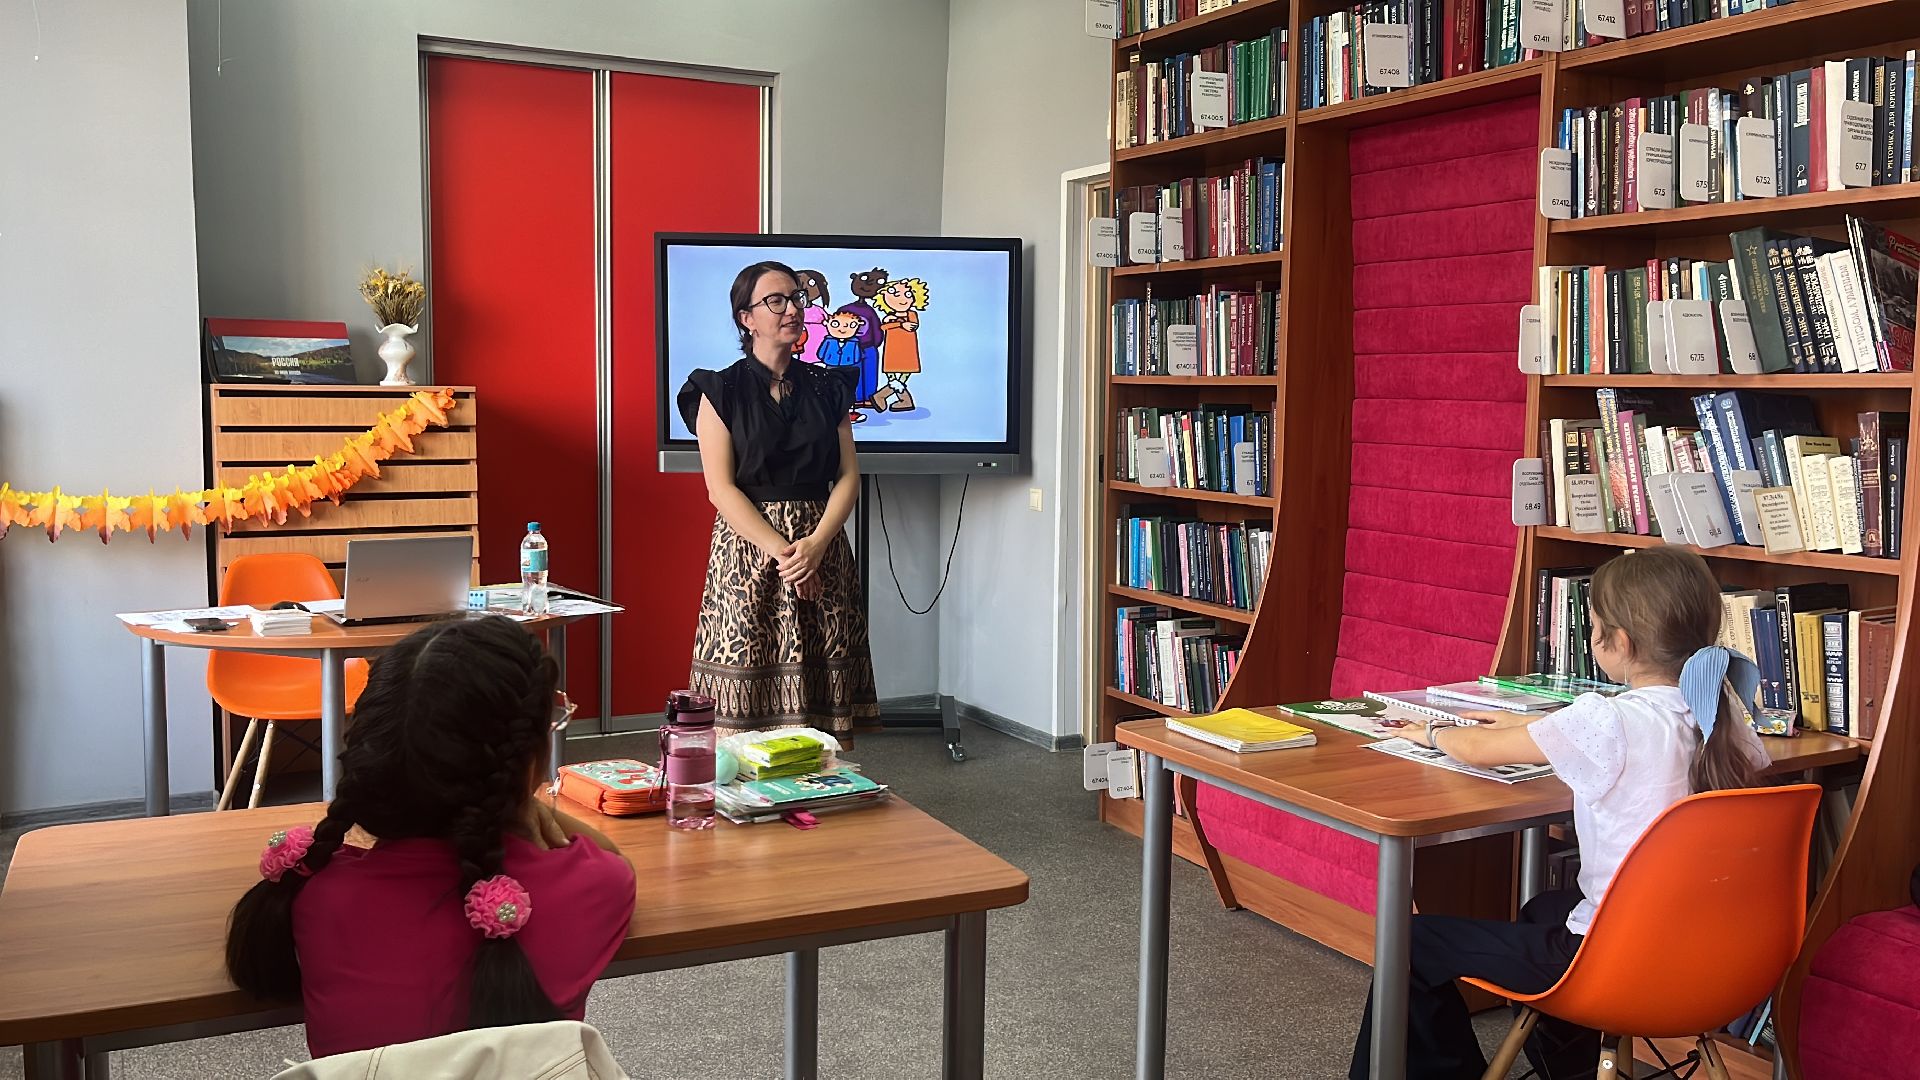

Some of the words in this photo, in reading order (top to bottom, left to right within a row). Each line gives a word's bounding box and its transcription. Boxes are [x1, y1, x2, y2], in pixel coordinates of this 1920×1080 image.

[1597, 14, 1616, 24] 67.412
[1533, 34, 1551, 43] 67.411
[1379, 68, 1400, 76] 67.408
[1889, 70, 1897, 109] ЮРИСТОВ
[1888, 110, 1896, 127] ДЛЯ
[1887, 129, 1895, 170] РИТОРИКА
[1855, 162, 1868, 171] 67.7
[1755, 175, 1771, 185] 67.52
[1653, 187, 1667, 197] 67.5
[1774, 271, 1790, 315] ДЕЛЬБРЮК
[1787, 271, 1804, 315] ДЕЛЬБРЮК
[1810, 270, 1826, 315] ДЕЛЬБРЮК
[1784, 316, 1796, 338] ГАНС
[1797, 316, 1809, 338] ГАНС
[1821, 317, 1832, 339] ГАНС
[271, 357, 300, 367] РОССИЯ
[1623, 422, 1634, 457] ТЮЛЕНЕВ
[1627, 457, 1638, 483] АРМИИ
[1525, 502, 1541, 511] 68.49
[1631, 484, 1642, 516] ГЕНЕРАЛ
